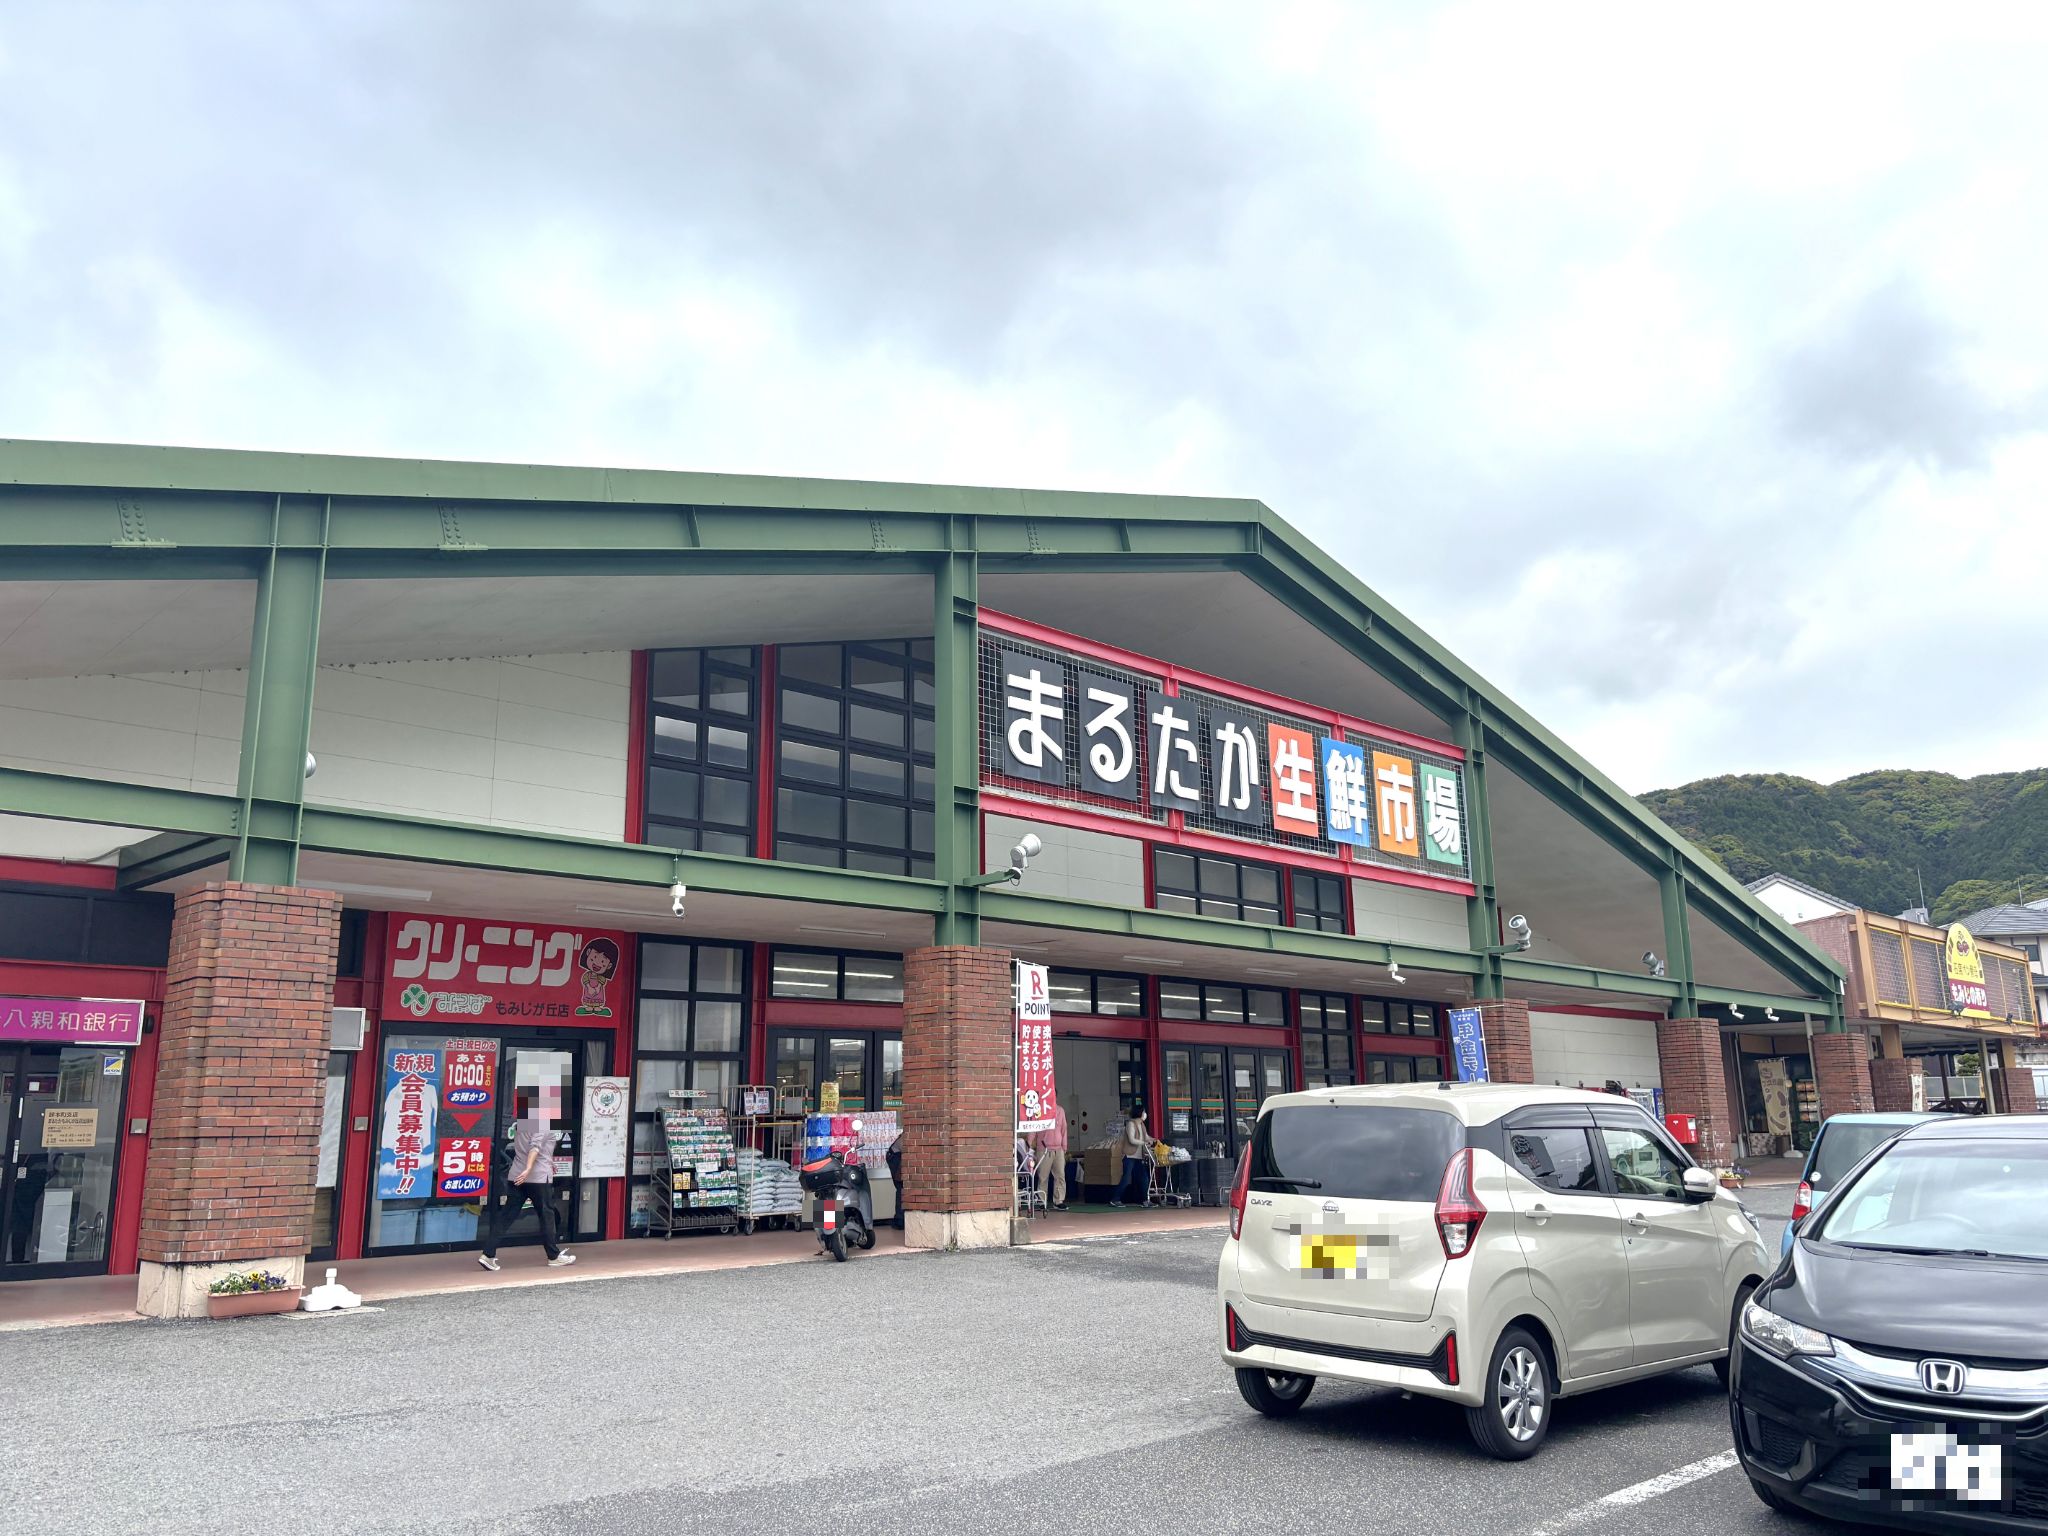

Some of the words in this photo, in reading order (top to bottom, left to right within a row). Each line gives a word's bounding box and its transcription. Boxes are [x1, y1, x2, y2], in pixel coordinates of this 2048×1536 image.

[1006, 668, 1461, 854] まるたか生鮮市場
[392, 919, 582, 987] クリーニング
[495, 1001, 570, 1018] もみじが丘店
[1024, 1002, 1050, 1015] POINT
[0, 1009, 133, 1033] 八親和銀行
[394, 1053, 435, 1073] 新規
[456, 1053, 486, 1063] あさ
[1021, 1025, 1031, 1087] 貯まる!
[1032, 1025, 1040, 1087] 使える!
[448, 1064, 484, 1087] 10:00
[1041, 1025, 1053, 1115] 楽天ポイント
[450, 1091, 487, 1102] お預かり
[451, 1139, 480, 1150] 夕方
[442, 1151, 467, 1175] 5
[470, 1151, 484, 1163] 時
[467, 1163, 485, 1173] には
[1250, 1198, 1273, 1206] DAYZ
